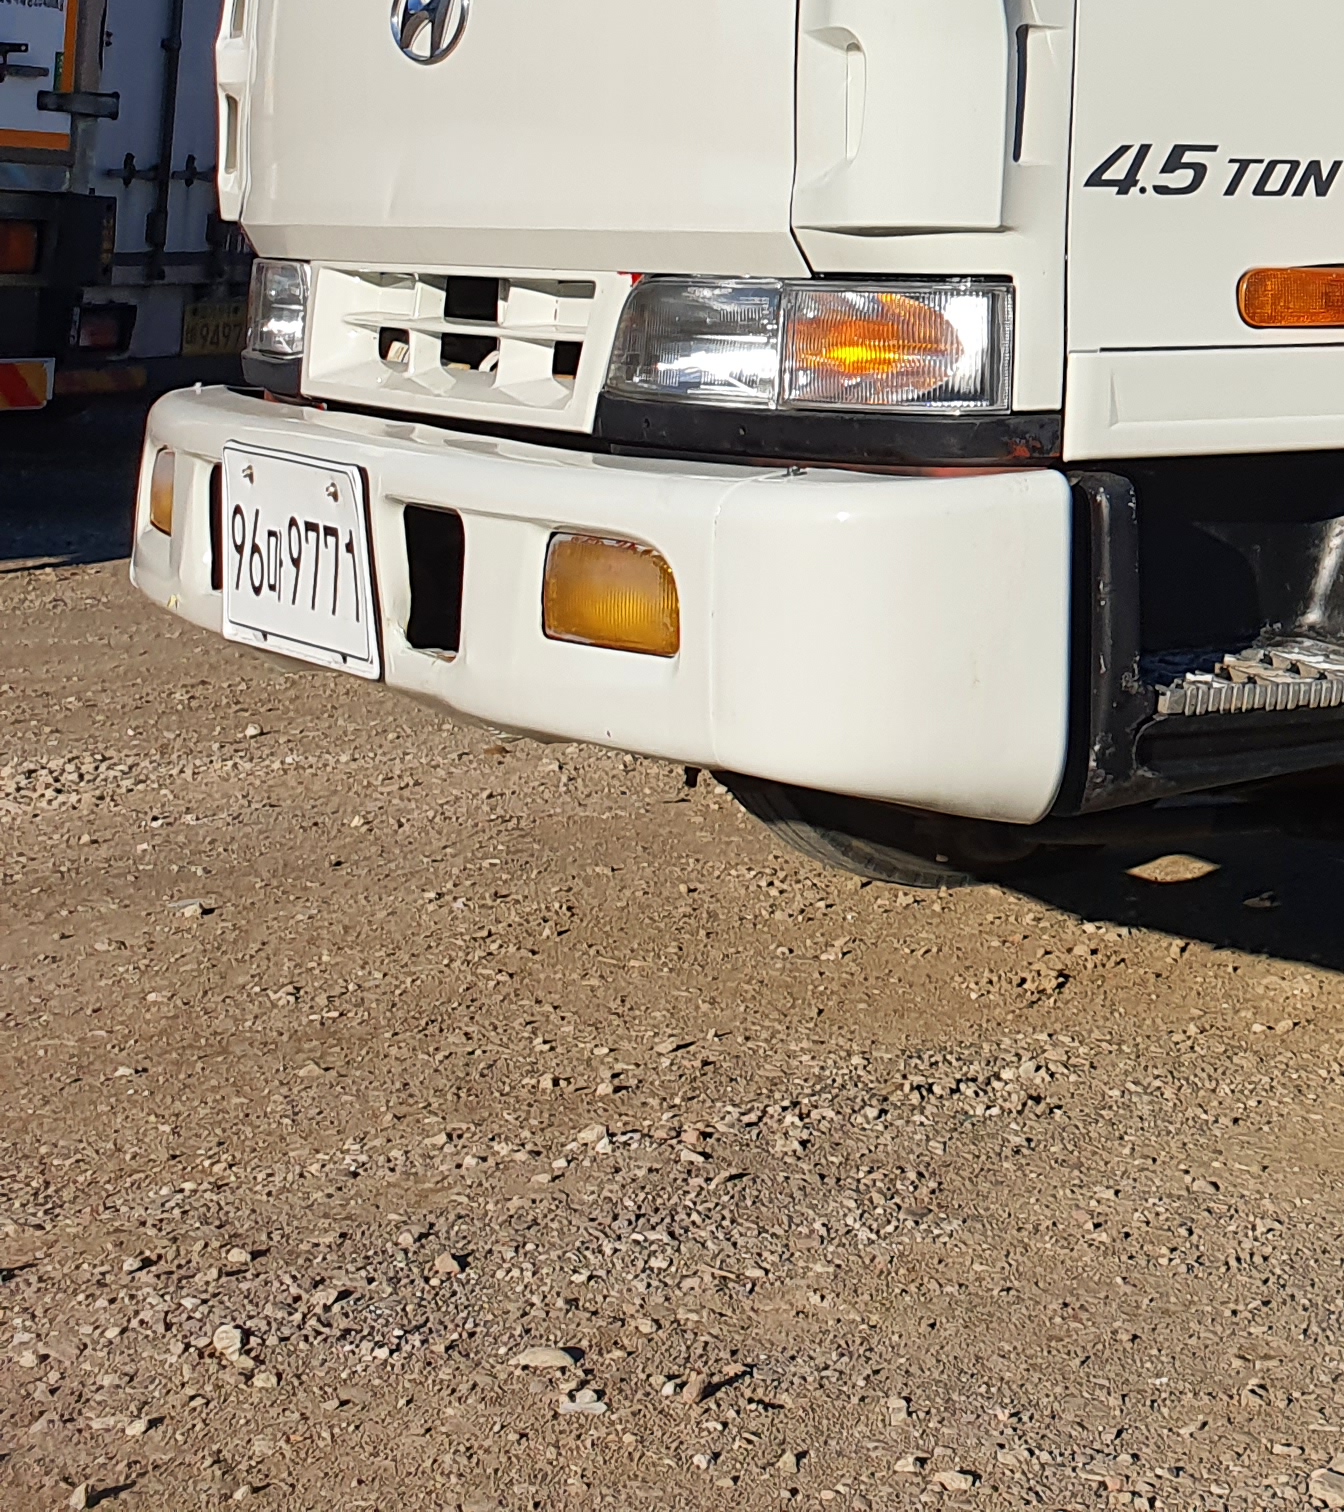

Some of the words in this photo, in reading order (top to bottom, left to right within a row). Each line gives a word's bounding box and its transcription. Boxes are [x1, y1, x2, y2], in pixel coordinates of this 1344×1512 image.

[1083, 144, 1219, 196] 4.5
[1222, 158, 1344, 197] TON
[231, 503, 360, 624] 96마9771
